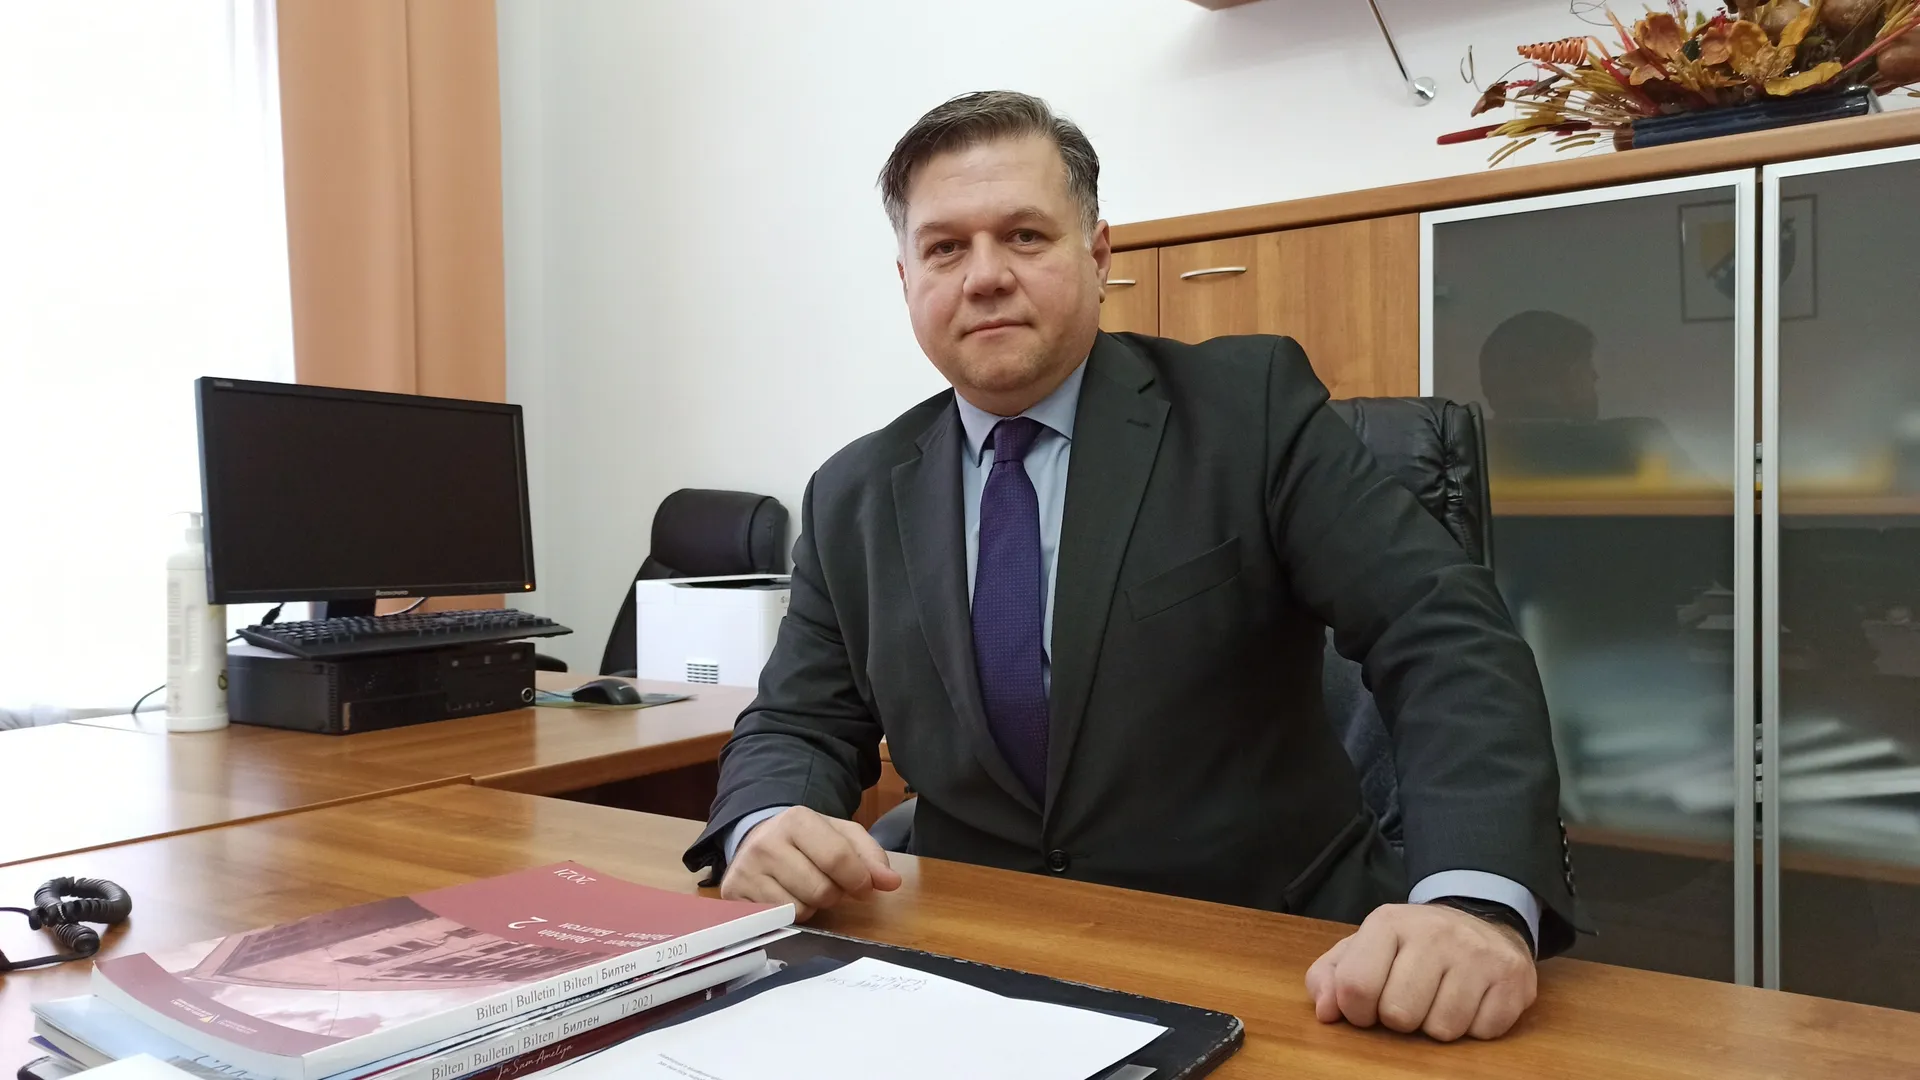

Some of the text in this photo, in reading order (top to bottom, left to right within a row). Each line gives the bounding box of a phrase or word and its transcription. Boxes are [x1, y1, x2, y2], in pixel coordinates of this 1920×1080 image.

[554, 868, 596, 885] 2021
[508, 916, 548, 929] 2
[476, 1002, 508, 1021] Bilten
[516, 986, 556, 1007] Bulletin
[563, 976, 593, 992] Bilten
[602, 961, 637, 980] Билтен
[668, 943, 689, 960] 2021
[431, 1062, 465, 1080] Bilten
[473, 1043, 515, 1067] Bulletin
[523, 1031, 554, 1049] Bilten
[563, 1015, 600, 1035] Билтен
[632, 994, 654, 1011] 2021
